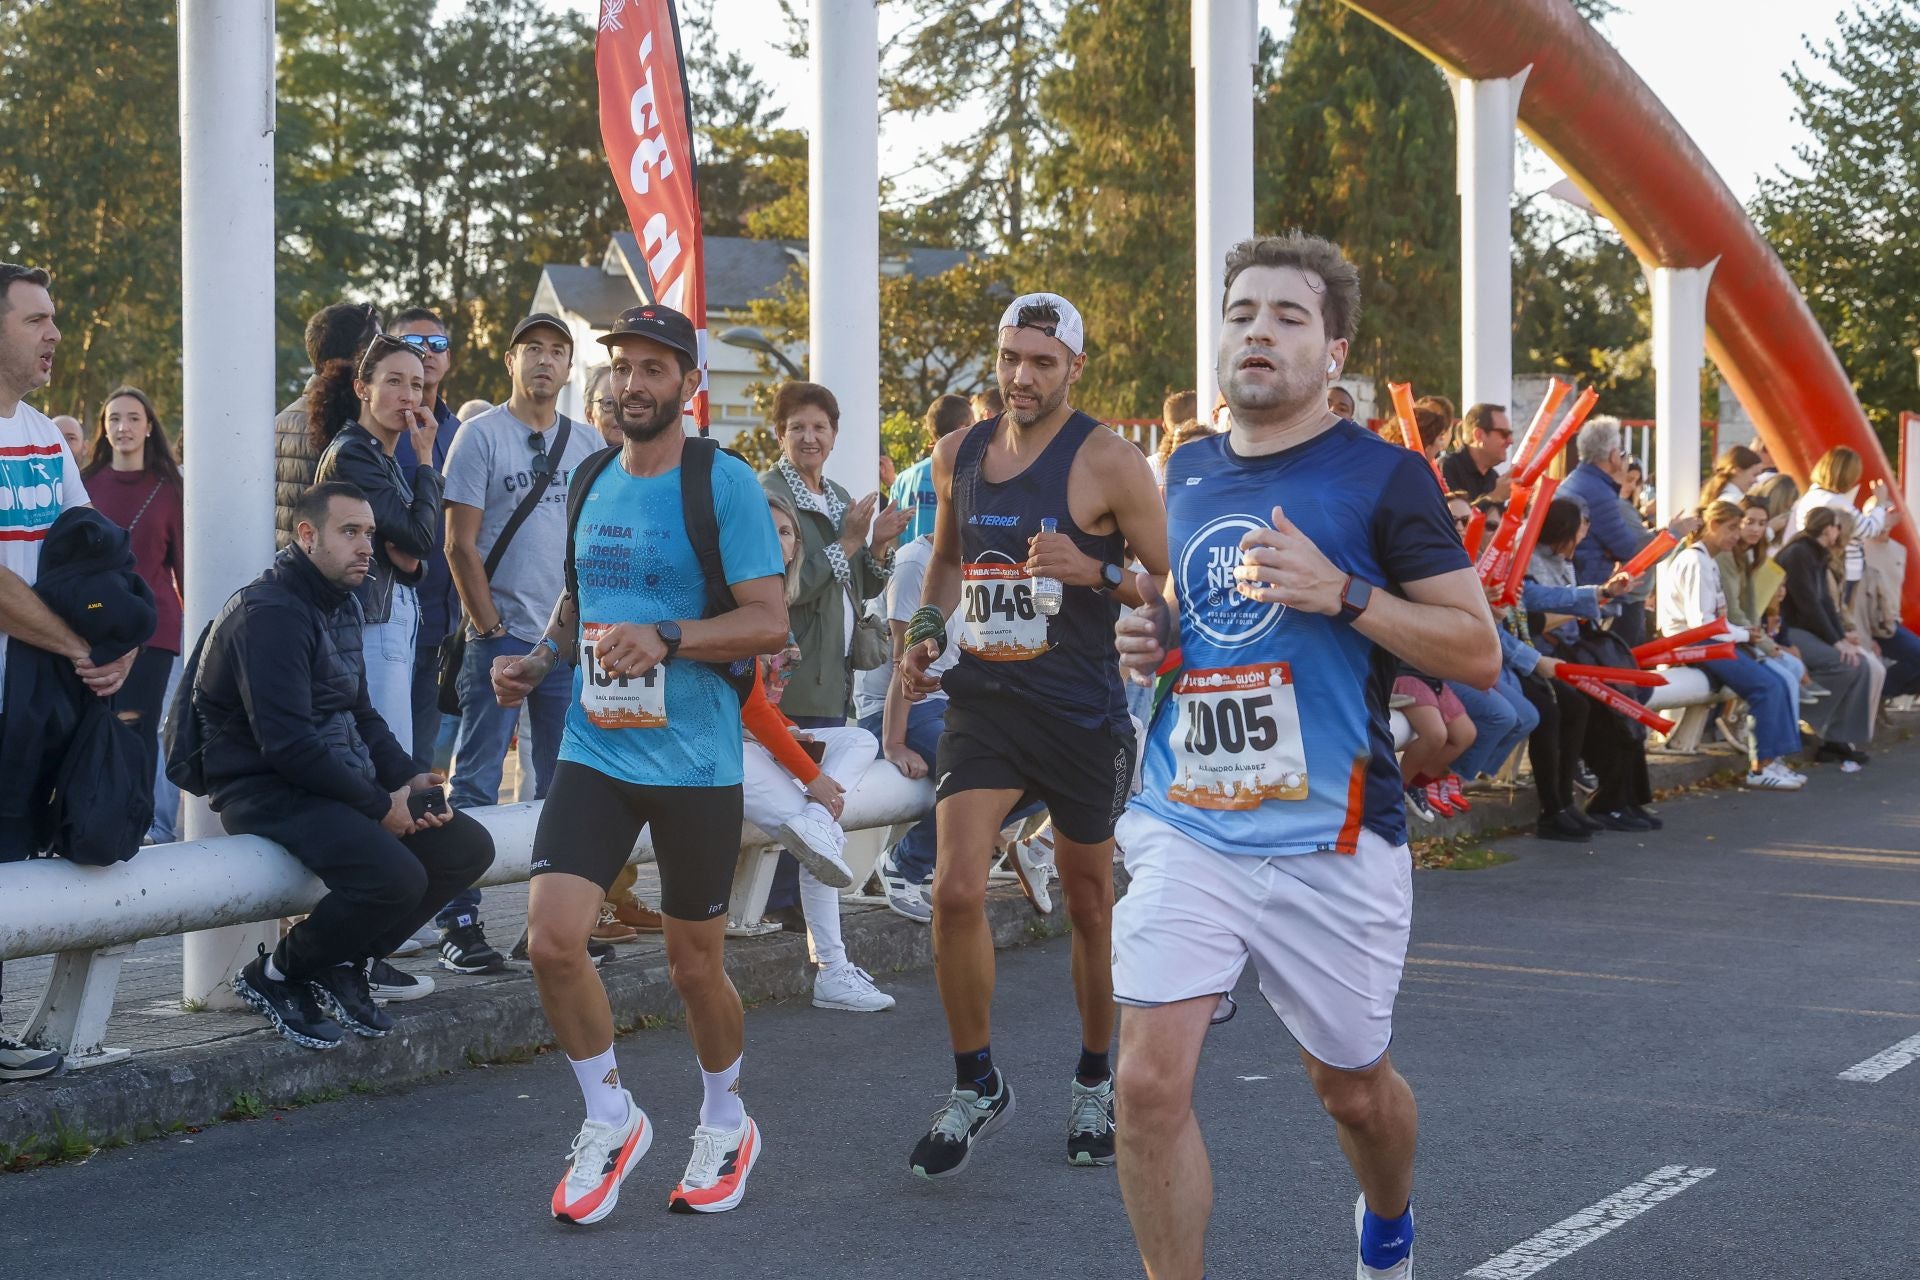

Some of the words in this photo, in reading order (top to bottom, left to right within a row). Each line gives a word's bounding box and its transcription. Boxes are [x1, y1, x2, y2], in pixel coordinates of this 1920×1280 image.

[980, 514, 1020, 527] TERREX
[598, 525, 632, 539] MBA
[589, 543, 632, 558] media
[965, 584, 1037, 623] 2046
[1235, 671, 1265, 685] GIJÓN
[1184, 694, 1278, 756] 1005
[1234, 763, 1266, 772] ÁLVAREZ
